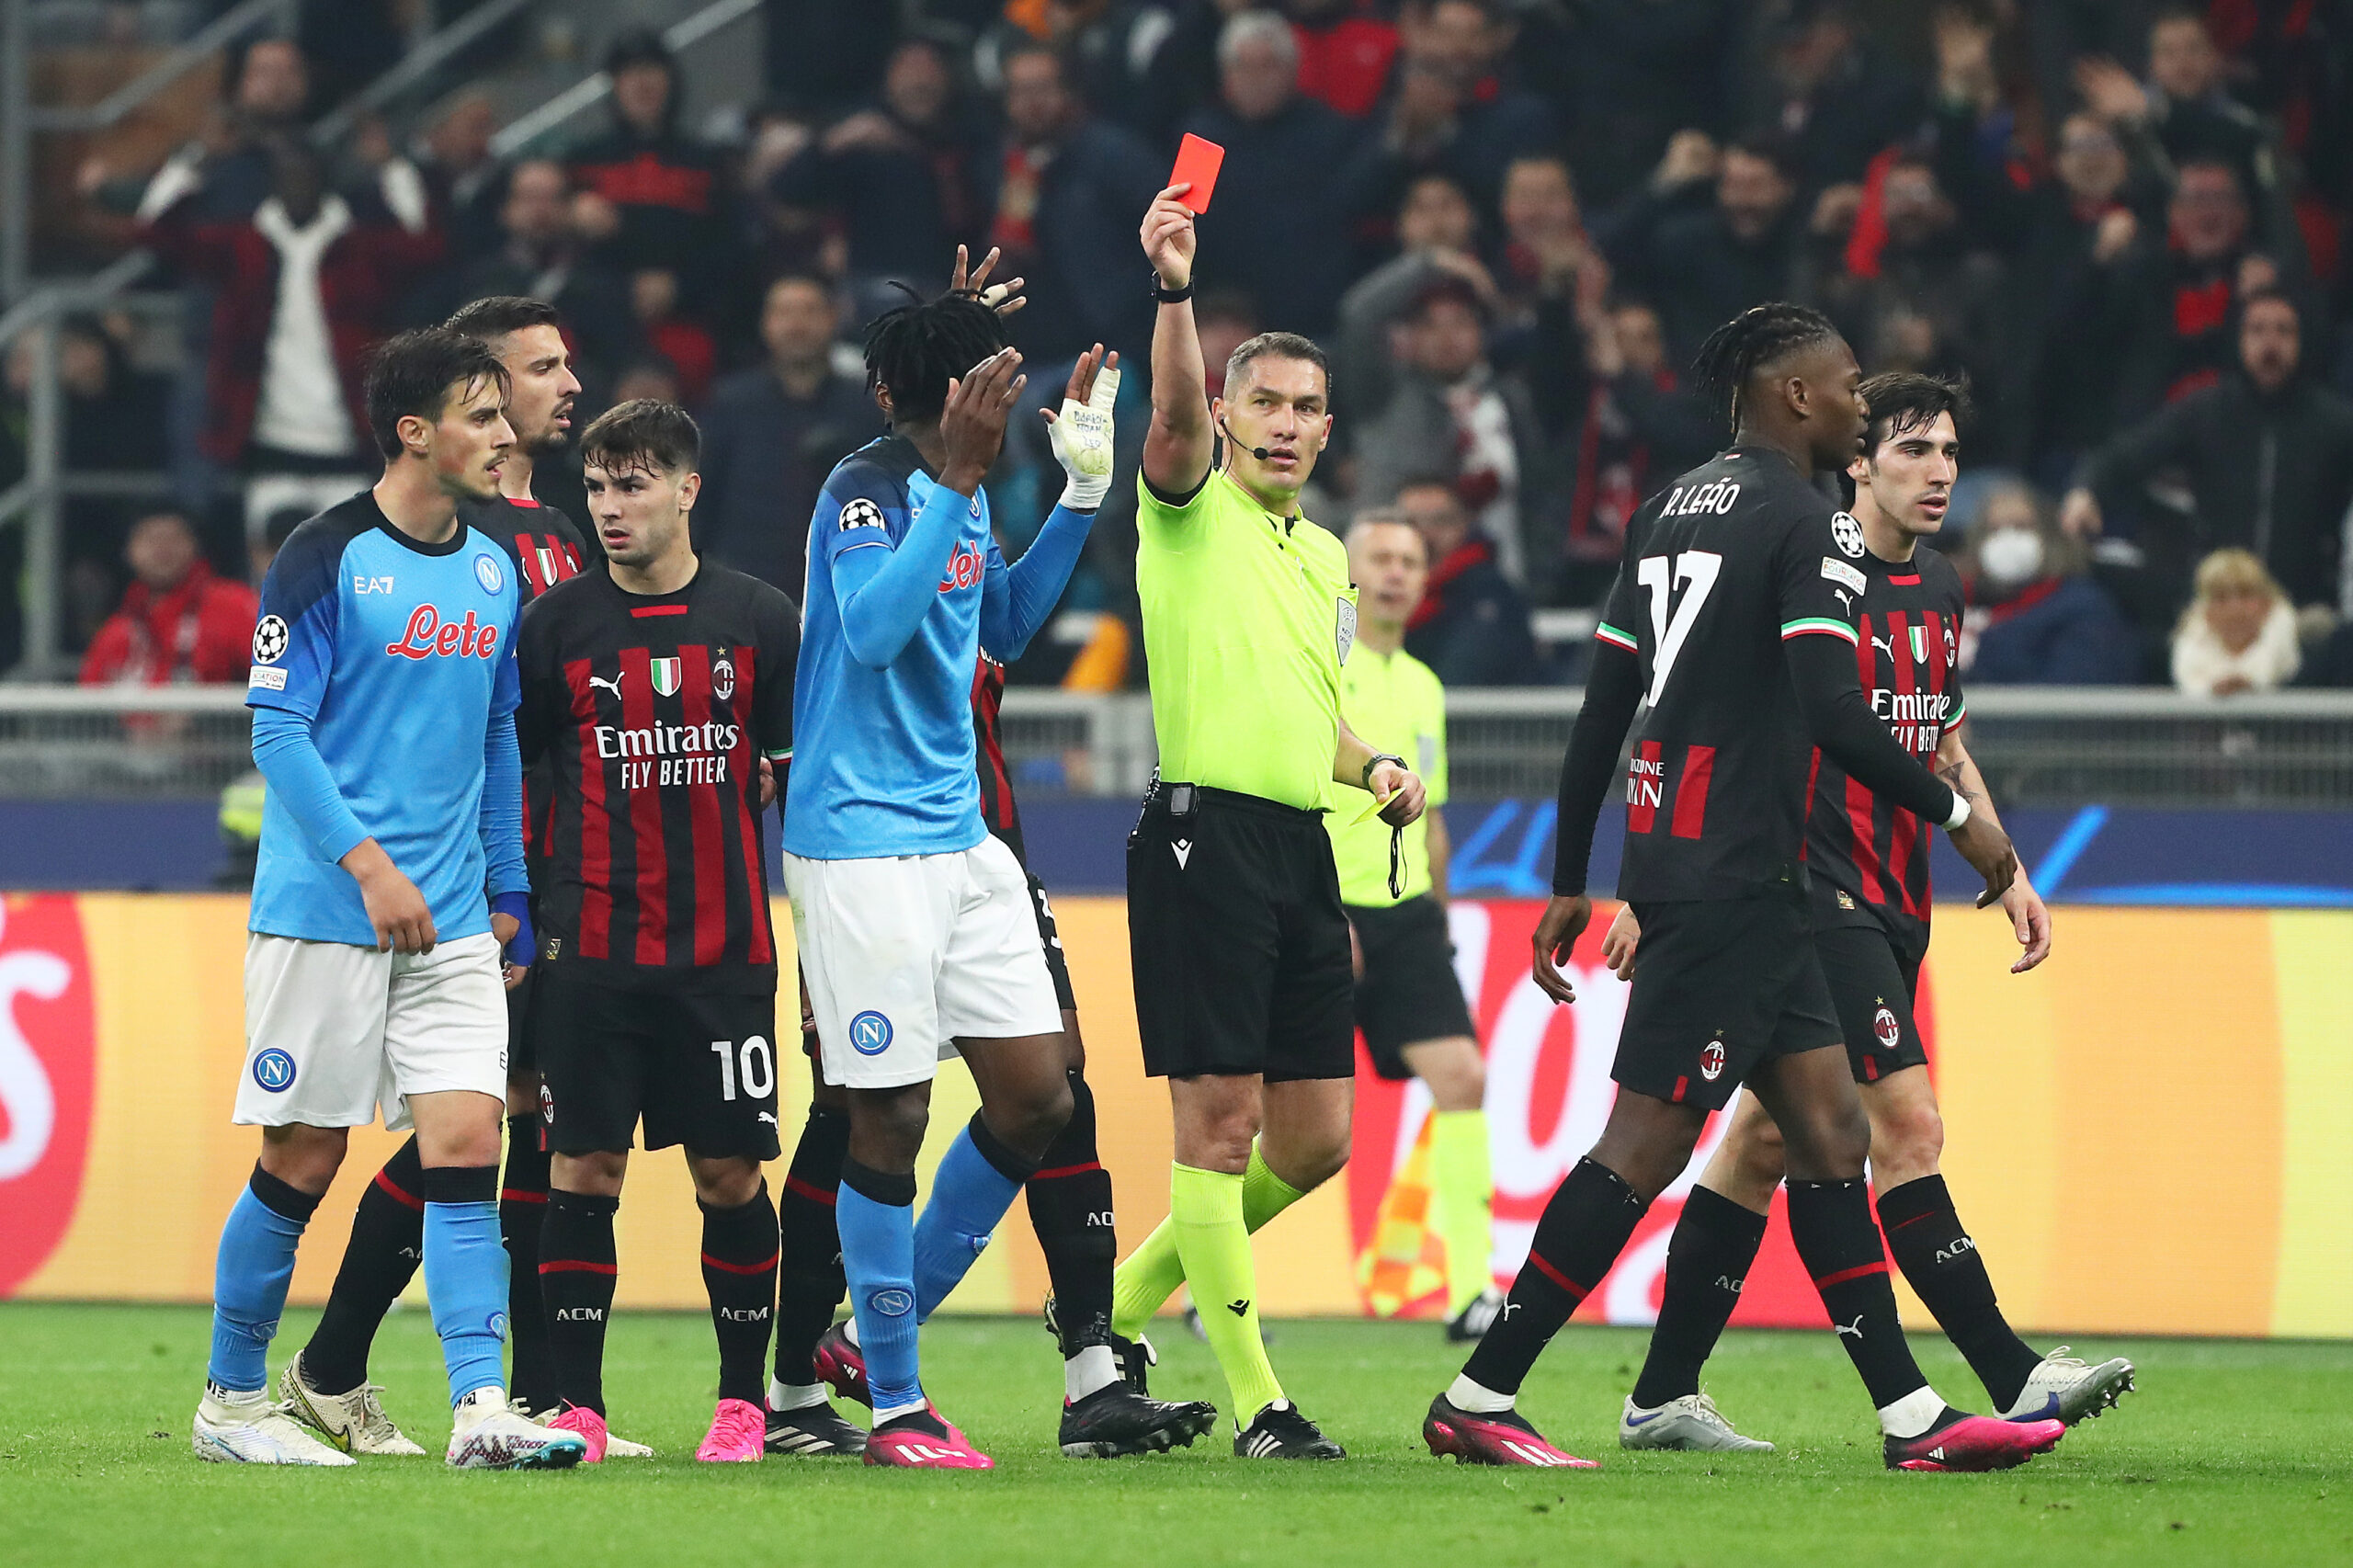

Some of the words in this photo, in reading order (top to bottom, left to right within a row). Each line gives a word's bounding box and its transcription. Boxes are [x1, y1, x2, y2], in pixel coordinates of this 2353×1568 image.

[1658, 476, 1741, 519] R.LEÃO
[353, 575, 394, 595] EA7
[482, 563, 496, 584] N
[386, 603, 497, 660] Lete
[1637, 550, 1723, 708] 17
[1870, 686, 1950, 721] Emirate
[593, 720, 740, 758] Emirates
[621, 761, 653, 790] FLY
[659, 756, 726, 786] BETTER
[859, 1022, 881, 1043] N
[264, 1059, 285, 1082] N
[710, 1035, 774, 1101] 10
[1936, 1236, 1977, 1265] ACM
[556, 1308, 603, 1321] ACM
[721, 1306, 769, 1322] ACM
